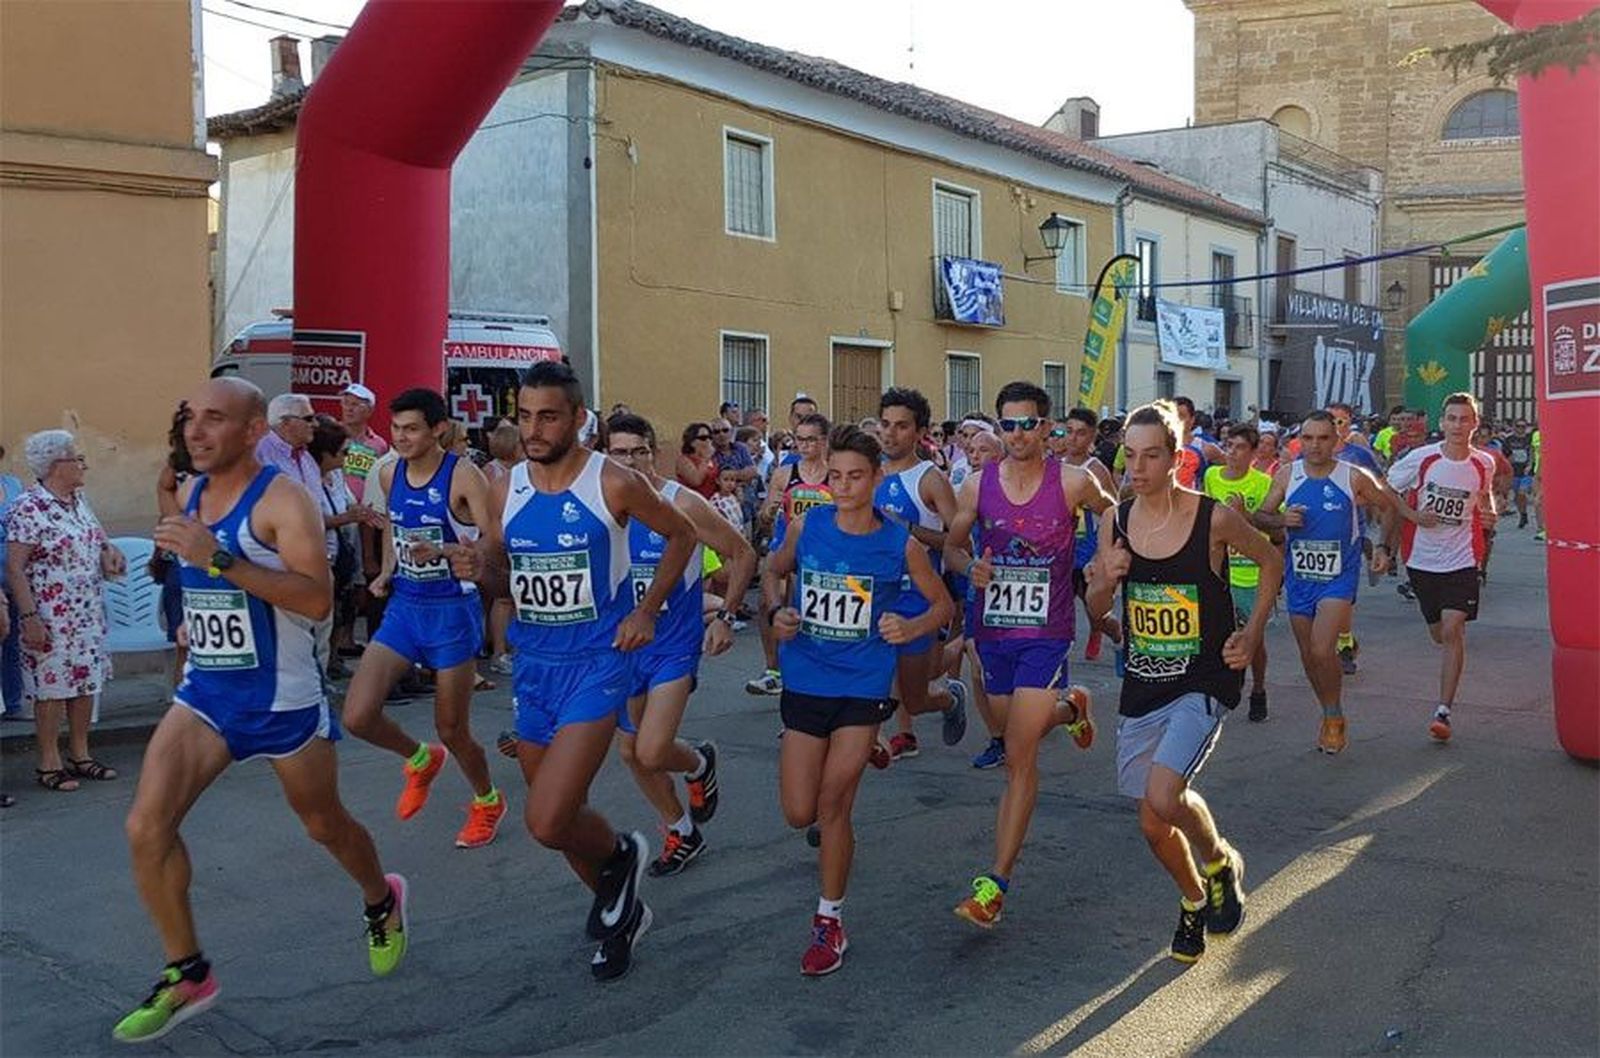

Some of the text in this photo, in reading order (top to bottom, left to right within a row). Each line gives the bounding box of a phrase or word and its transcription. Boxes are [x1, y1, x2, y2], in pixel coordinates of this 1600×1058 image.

[1288, 293, 1349, 325] VILLANUEVA
[335, 356, 354, 368] DE
[452, 345, 550, 361] AMBULANCIA
[1425, 494, 1464, 517] 2089
[1296, 552, 1337, 573] 2097
[516, 574, 584, 607] 2087
[989, 583, 1044, 613] 2115
[805, 589, 865, 625] 2117
[1135, 606, 1190, 635] 0508
